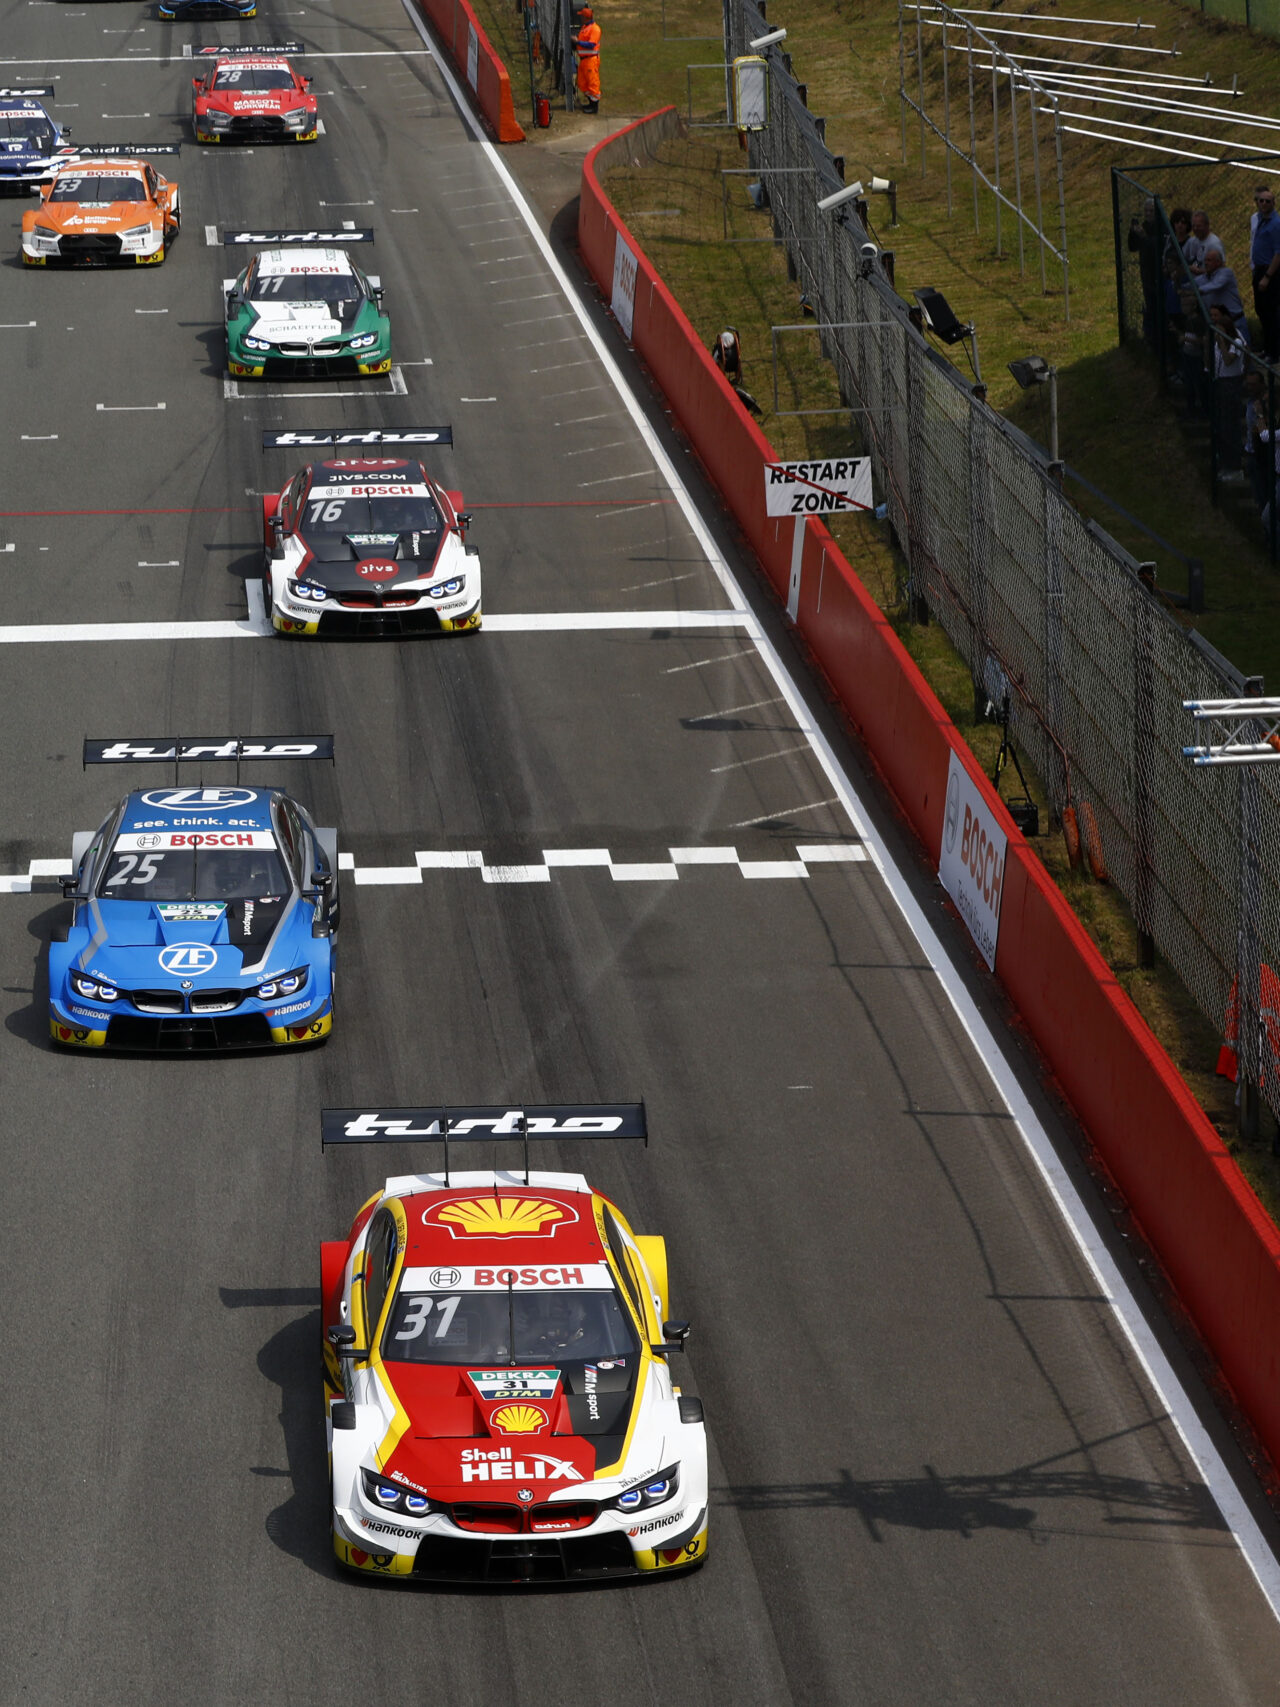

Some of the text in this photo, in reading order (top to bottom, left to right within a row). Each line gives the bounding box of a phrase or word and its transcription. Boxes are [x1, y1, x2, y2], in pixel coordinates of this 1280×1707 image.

[217, 72, 242, 83] 28
[54, 180, 82, 193] 53
[234, 232, 364, 242] turbo
[259, 276, 285, 294] 11
[269, 324, 336, 333] SCHAEFFLER
[276, 431, 439, 445] turbo
[329, 473, 407, 482] JIVS.COM
[771, 460, 861, 484] RESTART
[351, 486, 414, 495] BOSCH
[791, 491, 848, 513] ZONE
[310, 500, 346, 523] 16
[101, 741, 318, 758] turbo
[158, 789, 234, 803] ZF
[133, 817, 260, 829] see. think. act.
[170, 834, 254, 846] BOSCH
[961, 803, 1004, 919] BOSCH
[106, 854, 165, 887] 25
[169, 948, 207, 968] ZF
[344, 1111, 624, 1136] turbo
[474, 1267, 584, 1286] BOSCH
[396, 1296, 462, 1339] 31
[481, 1371, 552, 1381] DEKRA
[503, 1381, 528, 1390] 31
[494, 1389, 542, 1398] DTM
[461, 1447, 512, 1461] Shell
[461, 1453, 585, 1482] HELIX
[391, 1473, 428, 1494] HELIX ULTRA
[620, 1468, 656, 1489] HELIX ULTRA
